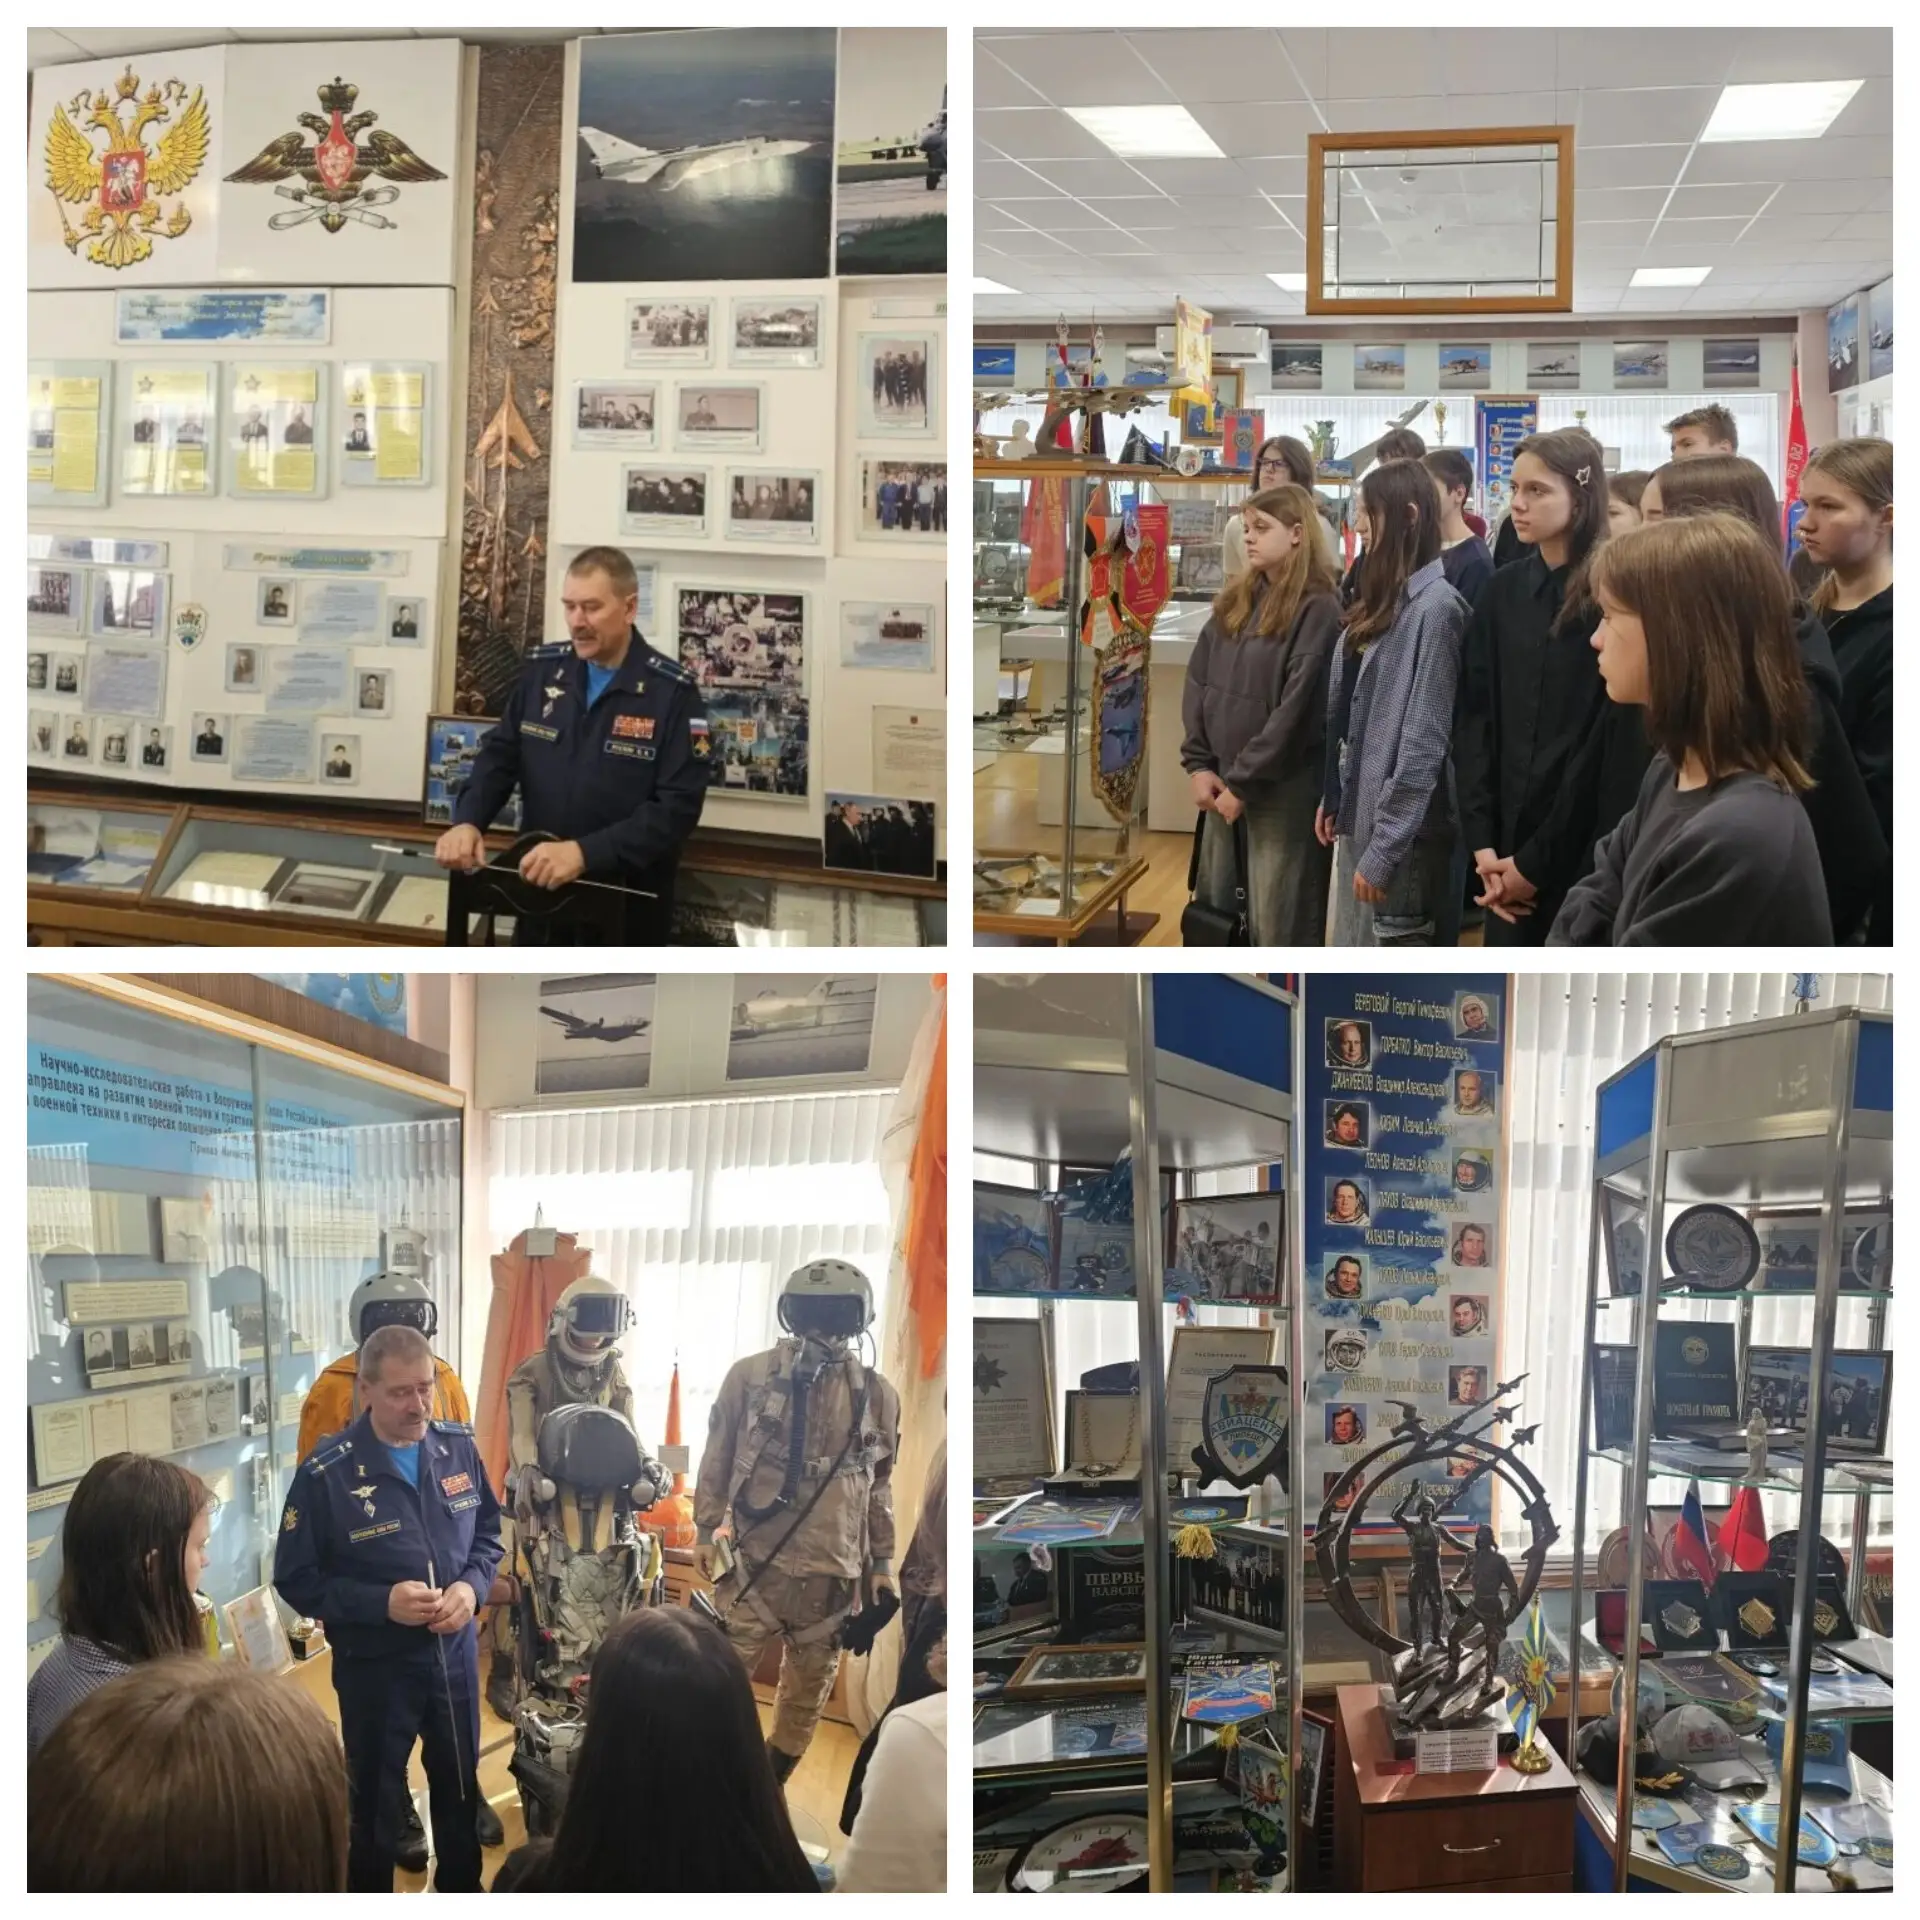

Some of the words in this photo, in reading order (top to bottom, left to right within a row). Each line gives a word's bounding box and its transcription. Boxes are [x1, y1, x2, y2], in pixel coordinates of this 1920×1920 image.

[27, 1072, 84, 1097] аправлена
[88, 1085, 100, 1100] на
[103, 1087, 145, 1108] развитие
[148, 1096, 183, 1114] военной
[39, 1052, 172, 1094] Научно-исследовательская
[175, 1084, 202, 1101] работа
[33, 1094, 78, 1115] военной
[81, 1102, 120, 1122] техники
[124, 1110, 130, 1123] в
[132, 1113, 176, 1131] интересах
[1210, 1415, 1283, 1438] АВИАЦЕНТР
